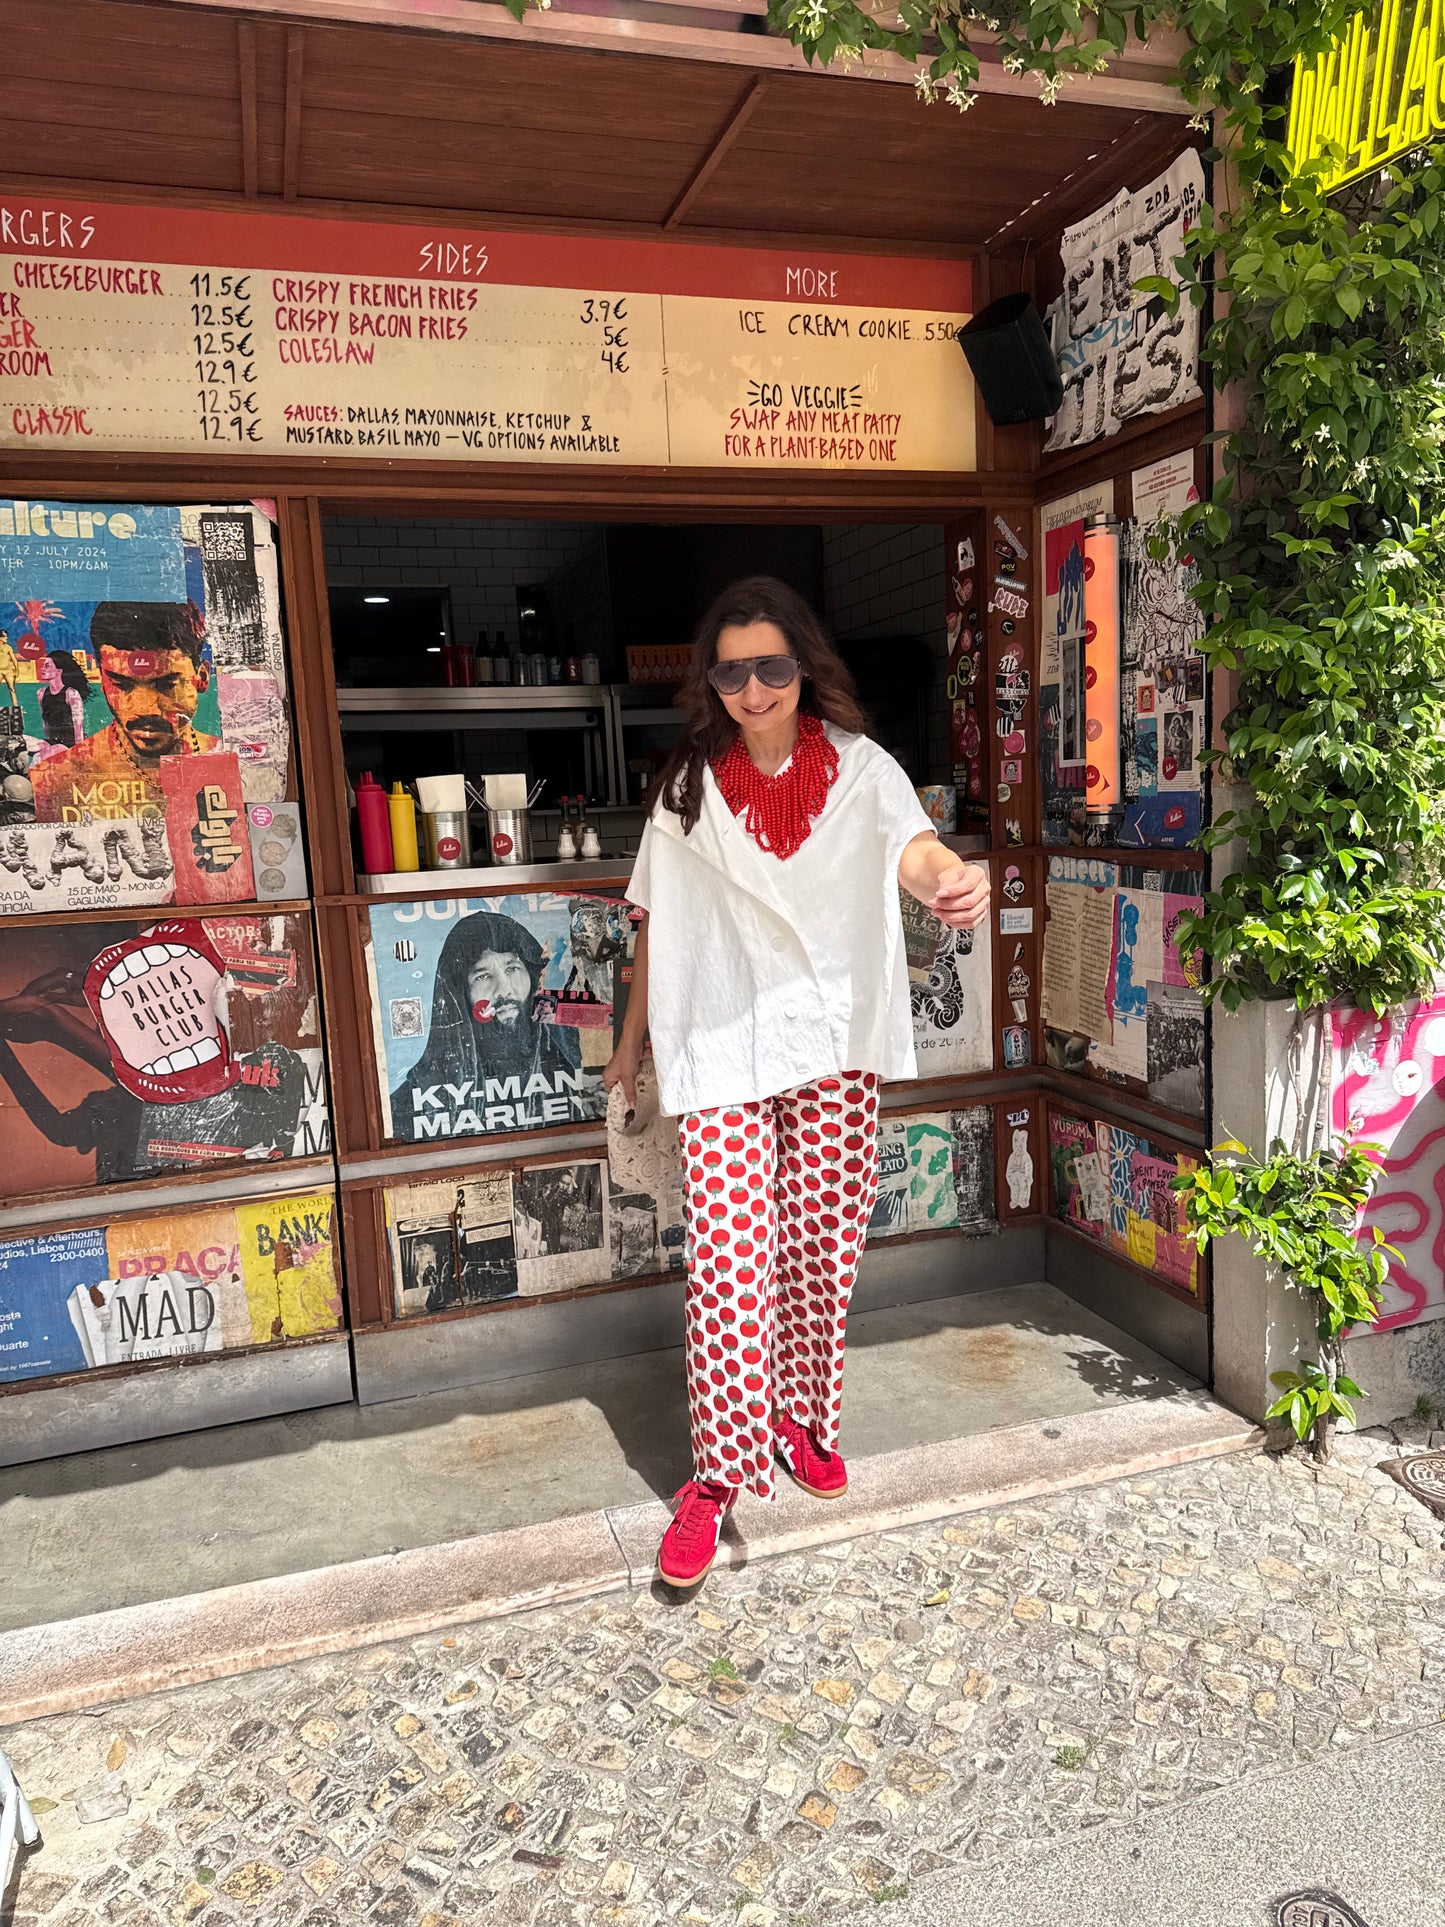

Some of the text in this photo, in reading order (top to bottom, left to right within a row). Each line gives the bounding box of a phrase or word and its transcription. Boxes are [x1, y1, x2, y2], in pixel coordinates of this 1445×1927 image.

[0, 207, 95, 249] RGERS
[419, 242, 489, 276] SIDES
[13, 261, 251, 301] CHEESEBURGER 11.5€
[786, 266, 838, 298] MORE
[272, 278, 628, 324] CRISPY FRENCH FRIES 3.9€
[191, 303, 253, 328] 12.5€
[275, 306, 629, 348] CRISPY BACON FRIES 5€
[738, 310, 766, 334] ICE
[788, 313, 850, 337] CREAM
[858, 319, 911, 340] COOKIE
[193, 332, 254, 357] 12.5€
[279, 337, 630, 374] COLESLAW 4€
[197, 389, 259, 414] 12.5€
[761, 384, 849, 410] GO VEGGIE
[13, 406, 263, 442] CLASSIC 12.9€
[283, 404, 344, 422] SAUCES:
[506, 412, 571, 431] KETCHUP
[730, 408, 901, 435] SWAP ANY MEAT PATTY
[358, 428, 401, 446] BASIL
[404, 430, 440, 447] MAYO
[462, 430, 484, 449] VG
[488, 431, 545, 450] OPTIONS
[550, 434, 621, 453] AVAILABLE
[724, 434, 897, 461] FOR A PLANT-BASED ONE
[16, 545, 30, 555] 12
[77, 547, 107, 557] 2024
[48, 559, 109, 570] 10PM/6AM
[72, 780, 149, 805] MOTEL
[14, 890, 31, 900] DA
[67, 887, 79, 896] 15
[81, 886, 94, 896] DE
[95, 884, 121, 895] MAIO
[128, 882, 167, 892] MONICA
[67, 895, 118, 906] GAGLIANO
[121, 965, 192, 1009] DALLAS
[132, 989, 206, 1031] BURGER
[155, 1014, 203, 1046] CLUB
[411, 1068, 585, 1112] KY-MAN
[413, 1095, 586, 1140] MARLEY
[271, 1203, 294, 1214] THE
[47, 1230, 103, 1243] Afterhours.
[255, 1210, 331, 1257] BANK
[31, 1244, 65, 1255] Lisboa
[51, 1247, 105, 1263] 2300-0400
[116, 1286, 215, 1343] MAD
[169, 1344, 197, 1357] LIVRE
